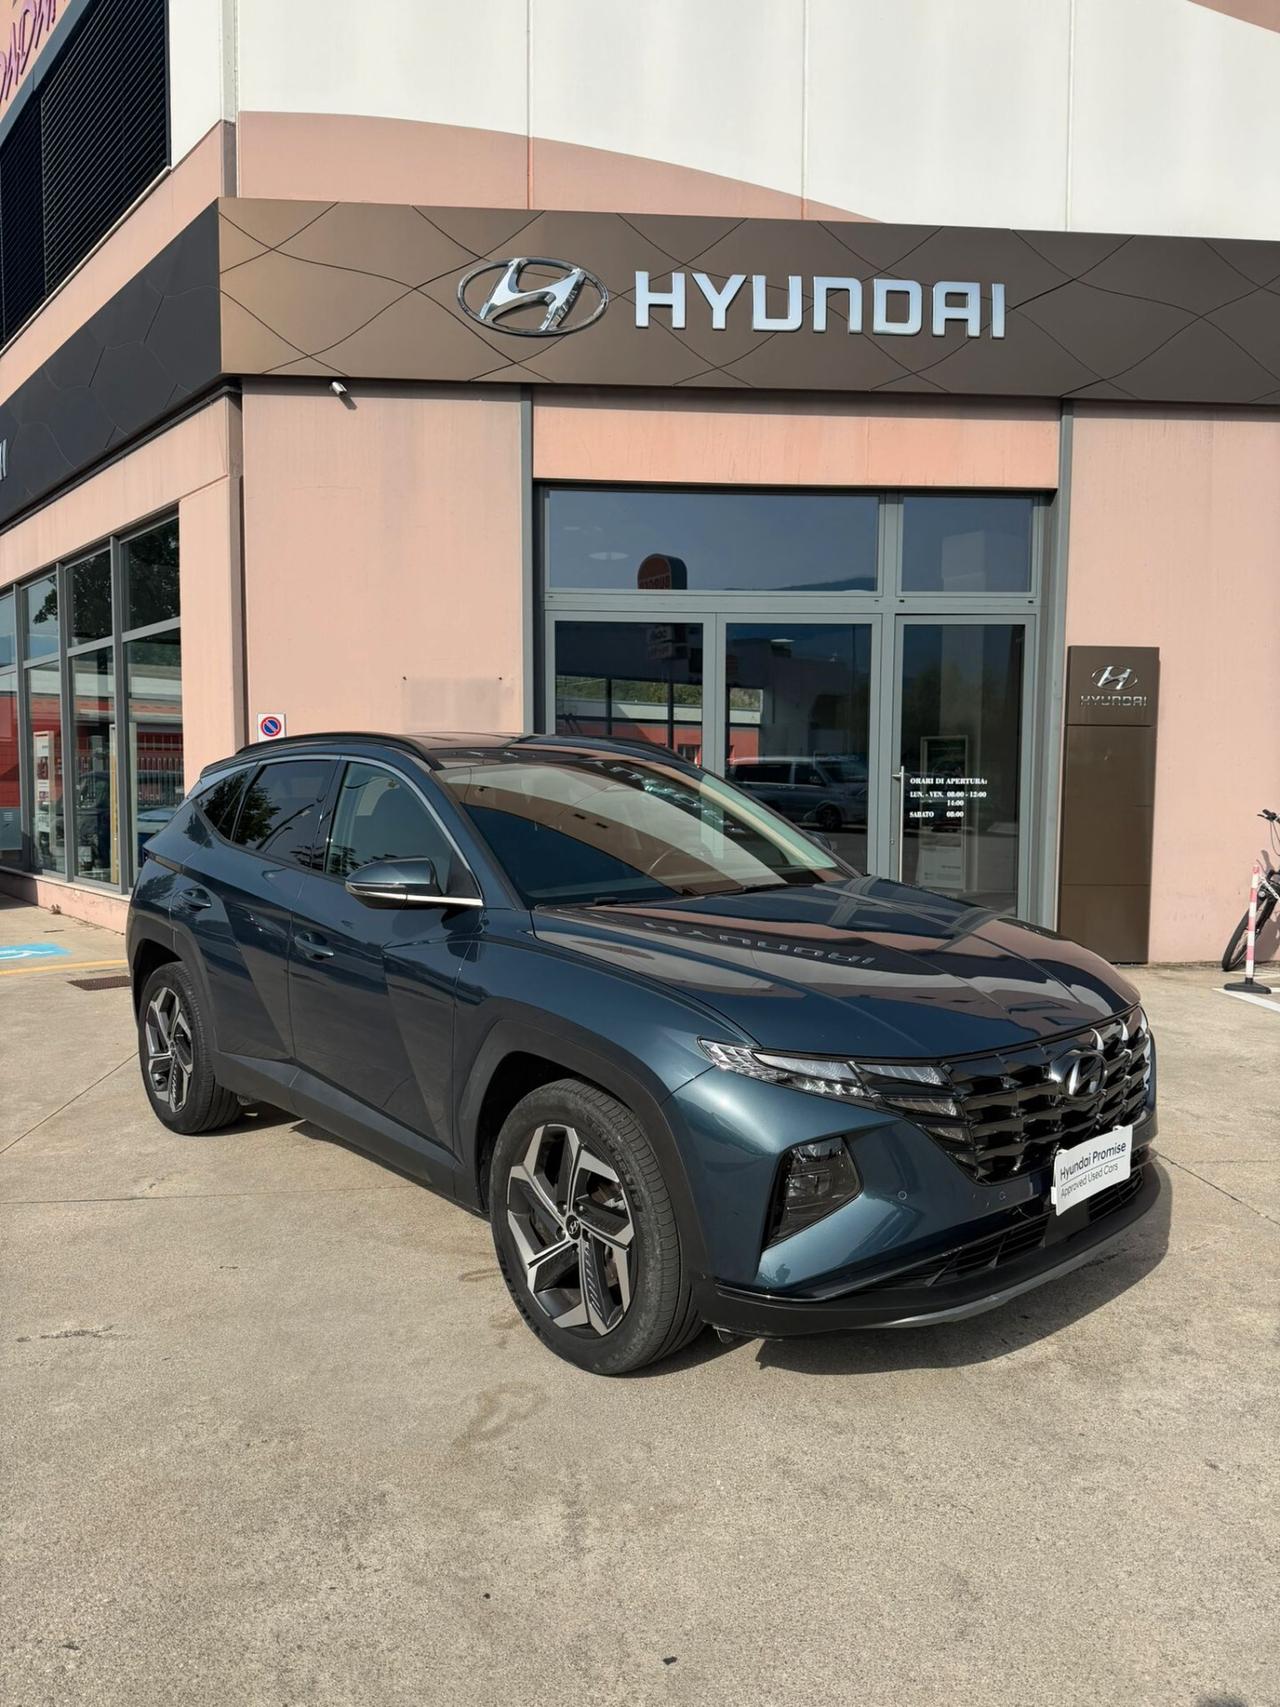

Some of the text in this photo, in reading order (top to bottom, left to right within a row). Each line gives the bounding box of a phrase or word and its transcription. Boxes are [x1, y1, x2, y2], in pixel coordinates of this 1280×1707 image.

[633, 269, 1007, 340] HYUNDAI
[1080, 695, 1147, 707] HYUNDAI
[1060, 1142, 1126, 1181] Hyundai Promise
[1061, 1163, 1119, 1198] Approved Used Cars
